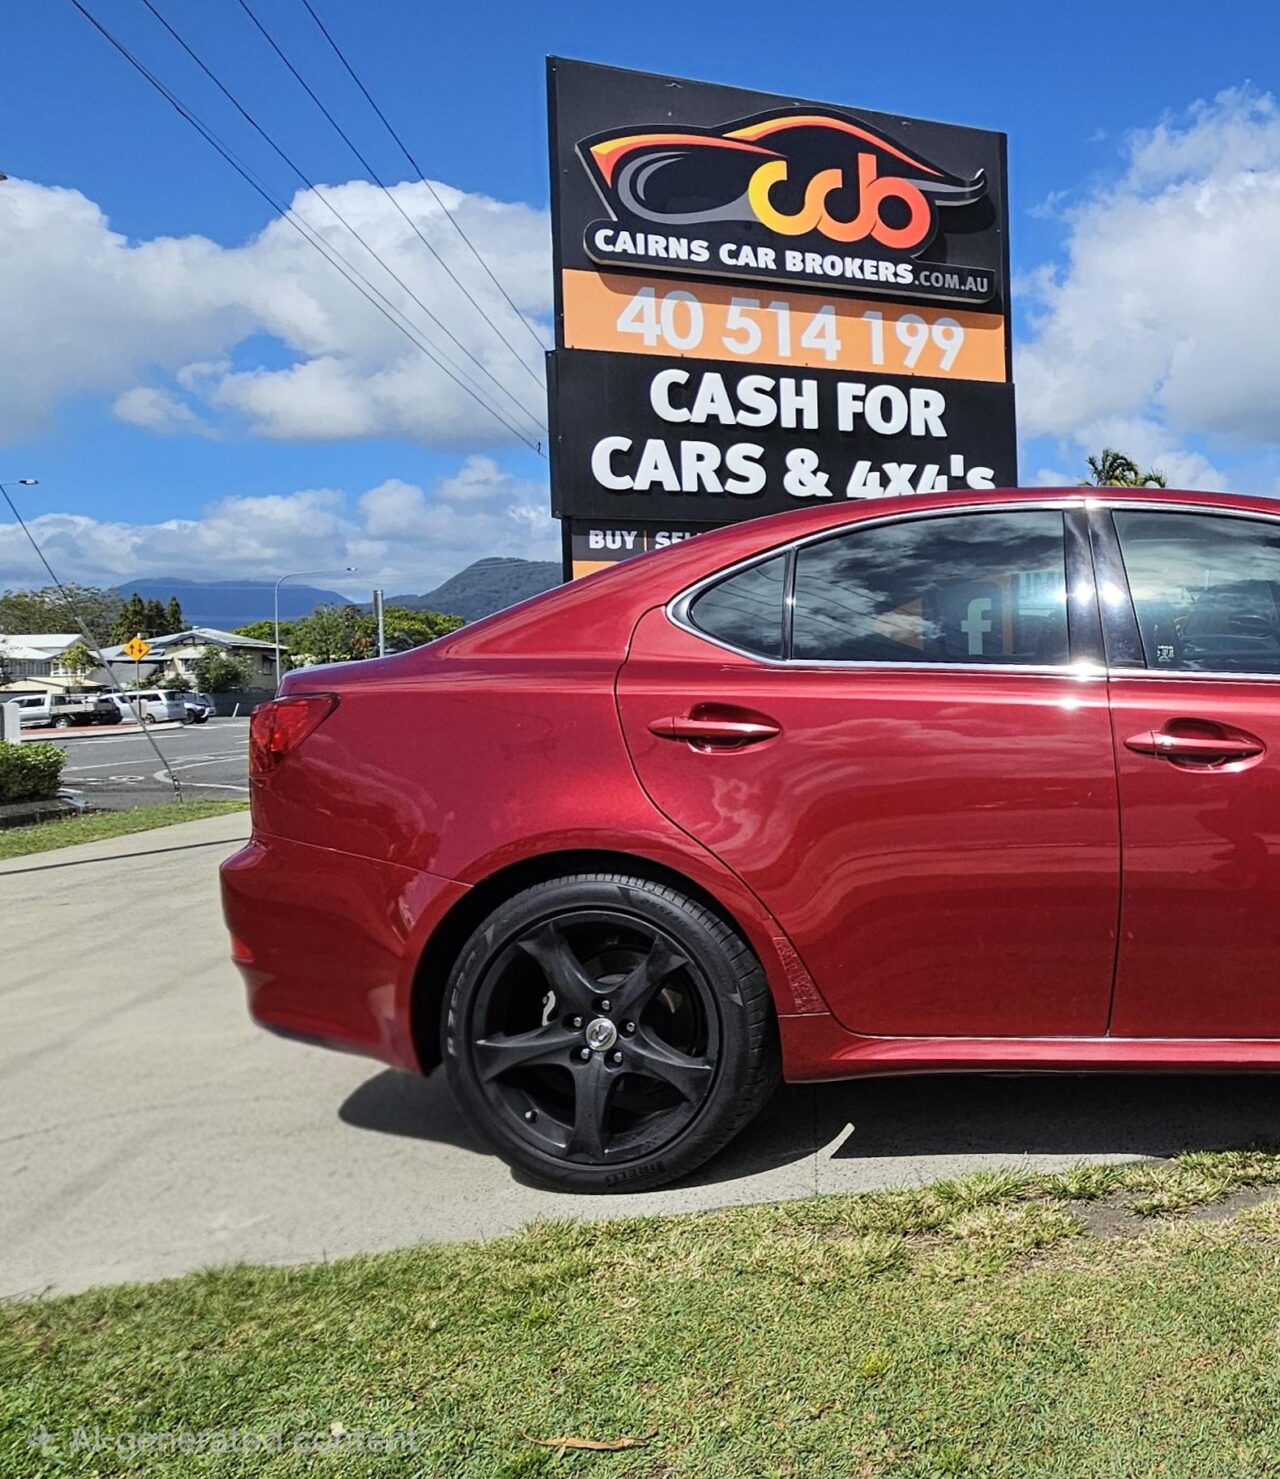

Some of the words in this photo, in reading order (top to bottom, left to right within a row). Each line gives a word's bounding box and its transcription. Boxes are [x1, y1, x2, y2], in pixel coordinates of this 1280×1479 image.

[594, 229, 709, 262] CAIRNS
[719, 243, 776, 271] CAR
[617, 287, 704, 350] 40
[722, 297, 841, 361] 514
[861, 311, 965, 371] 199
[650, 368, 818, 429] CASH
[837, 382, 947, 437] FOR
[591, 436, 767, 495] CARS
[783, 448, 833, 497] &
[589, 530, 637, 550] BUY
